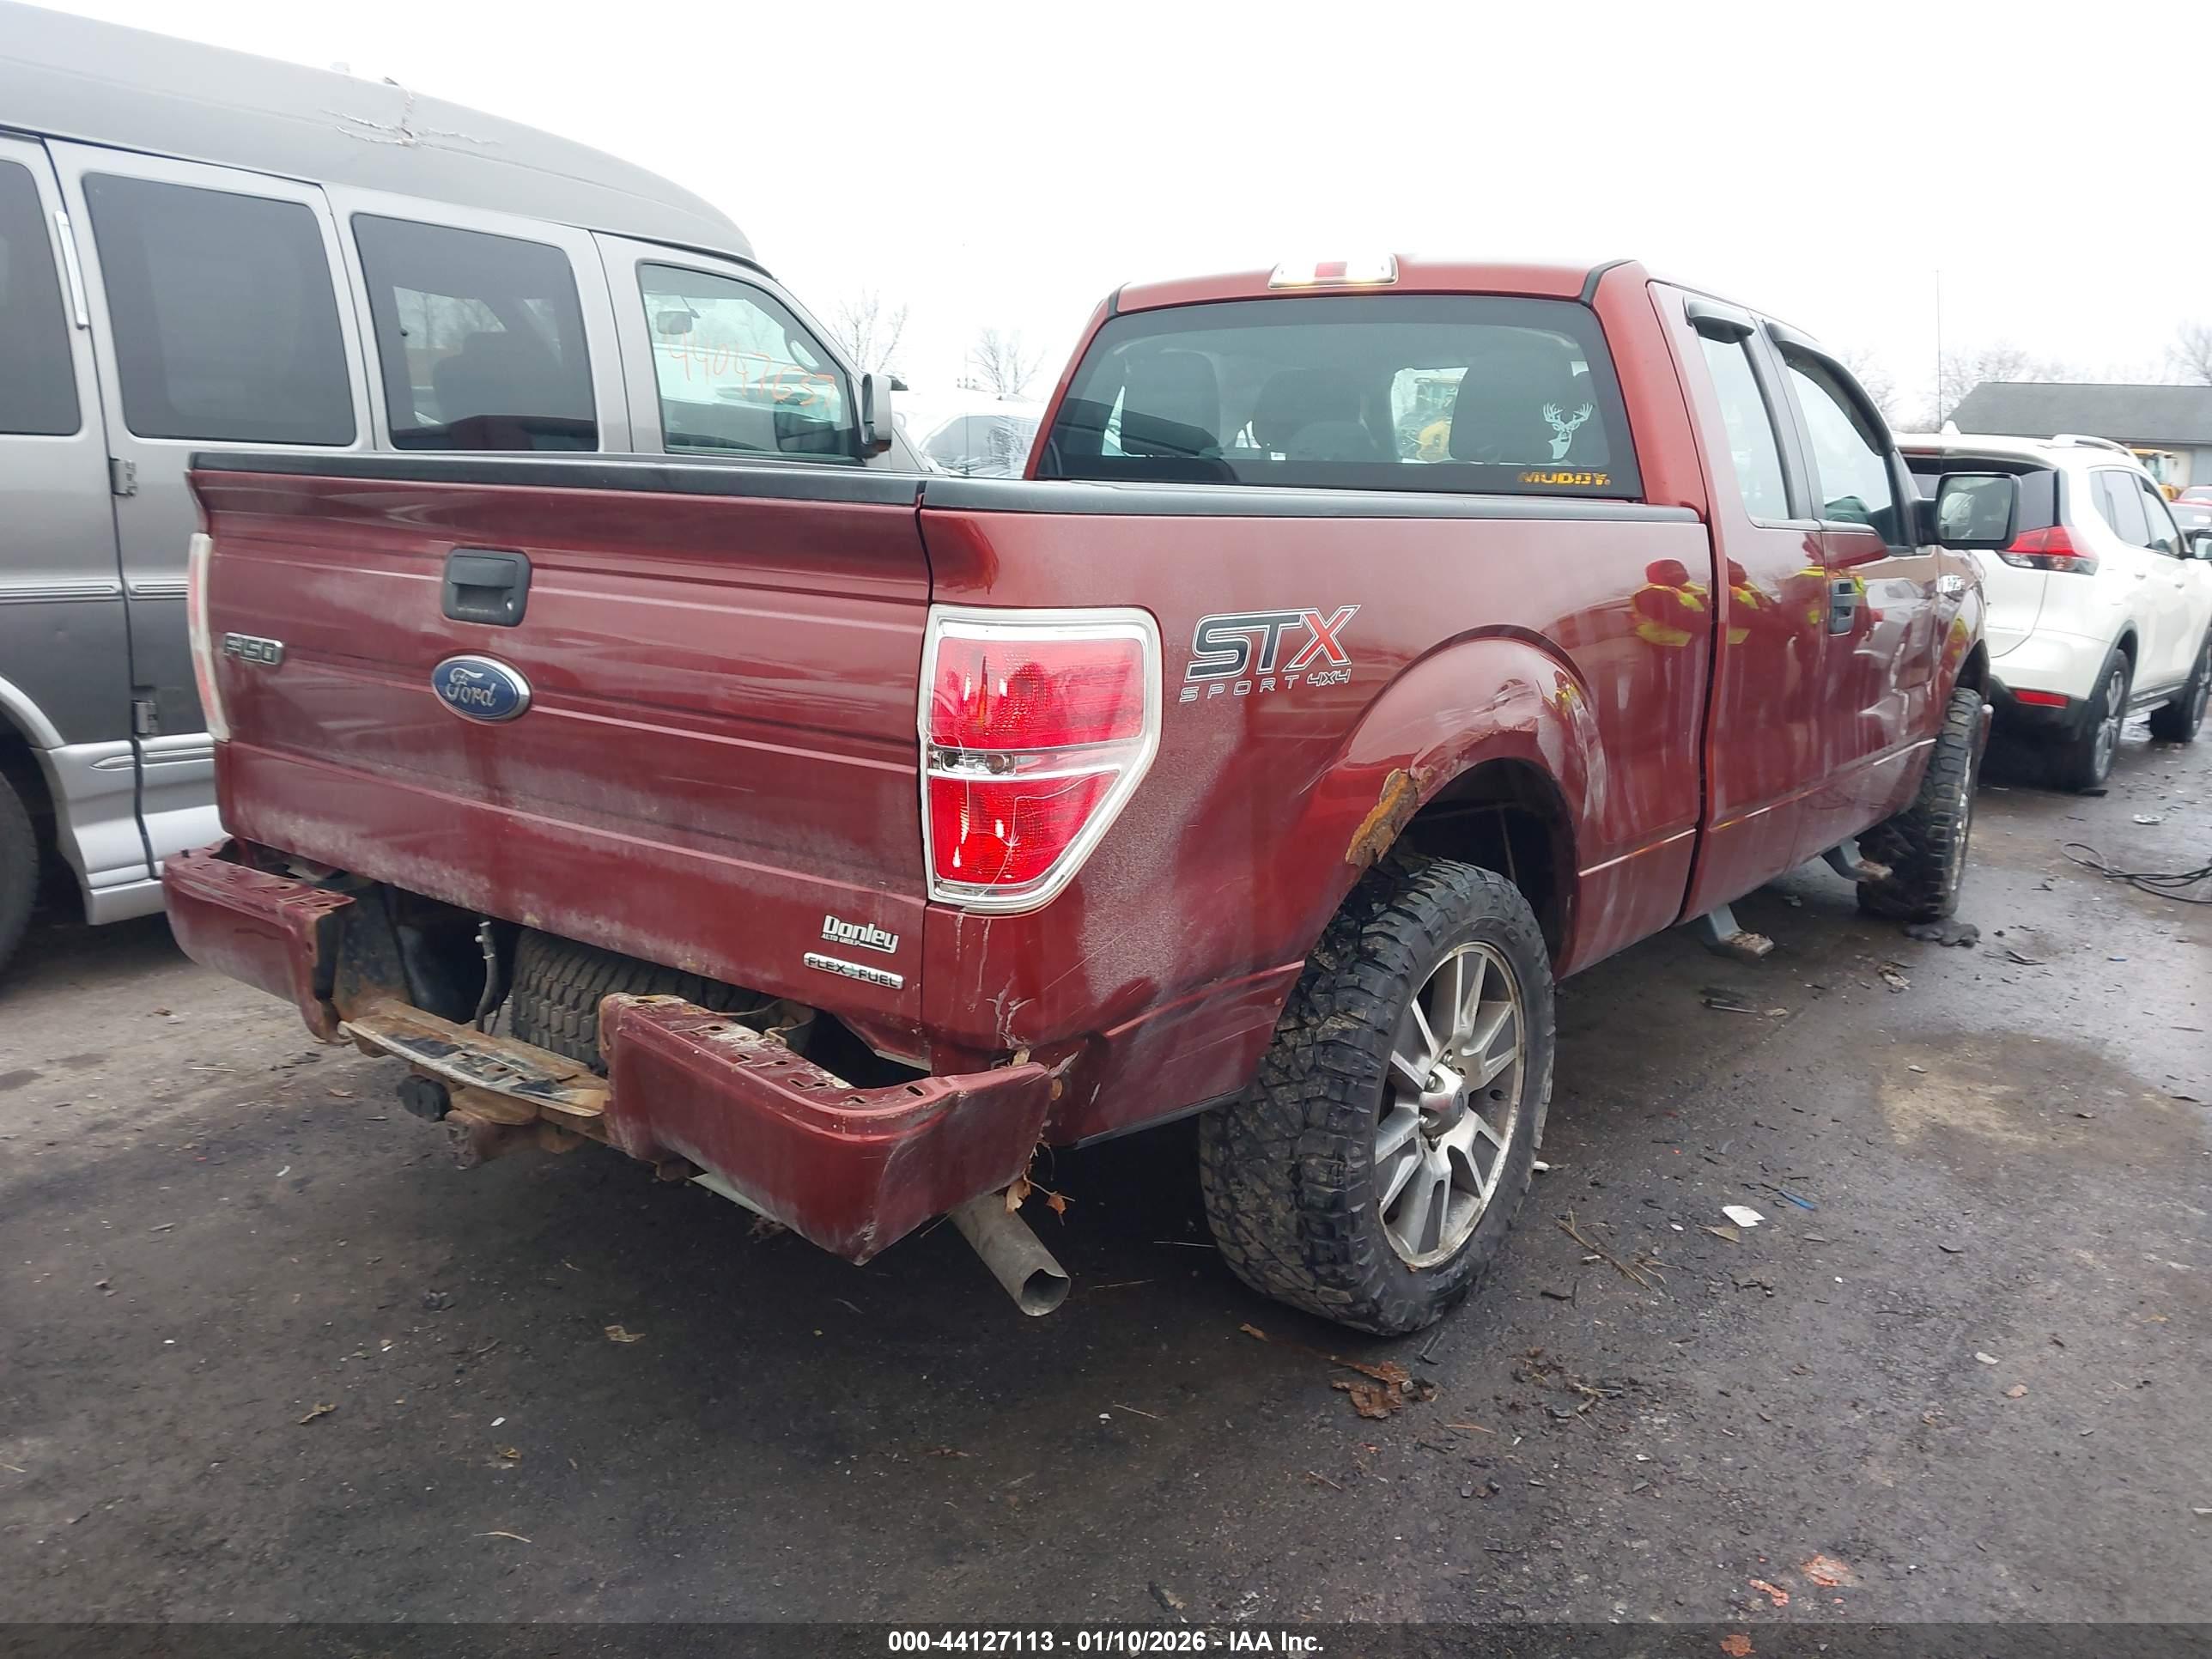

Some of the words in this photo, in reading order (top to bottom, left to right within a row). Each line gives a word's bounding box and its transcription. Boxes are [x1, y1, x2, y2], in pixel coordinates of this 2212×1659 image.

[1518, 472, 1607, 486] MUDDY
[1184, 604, 1361, 683] STX
[445, 667, 497, 707] Ford
[1179, 674, 1299, 702] SPORT
[823, 915, 899, 954] Donley
[807, 957, 846, 974] FLEX
[859, 969, 901, 988] FUEL
